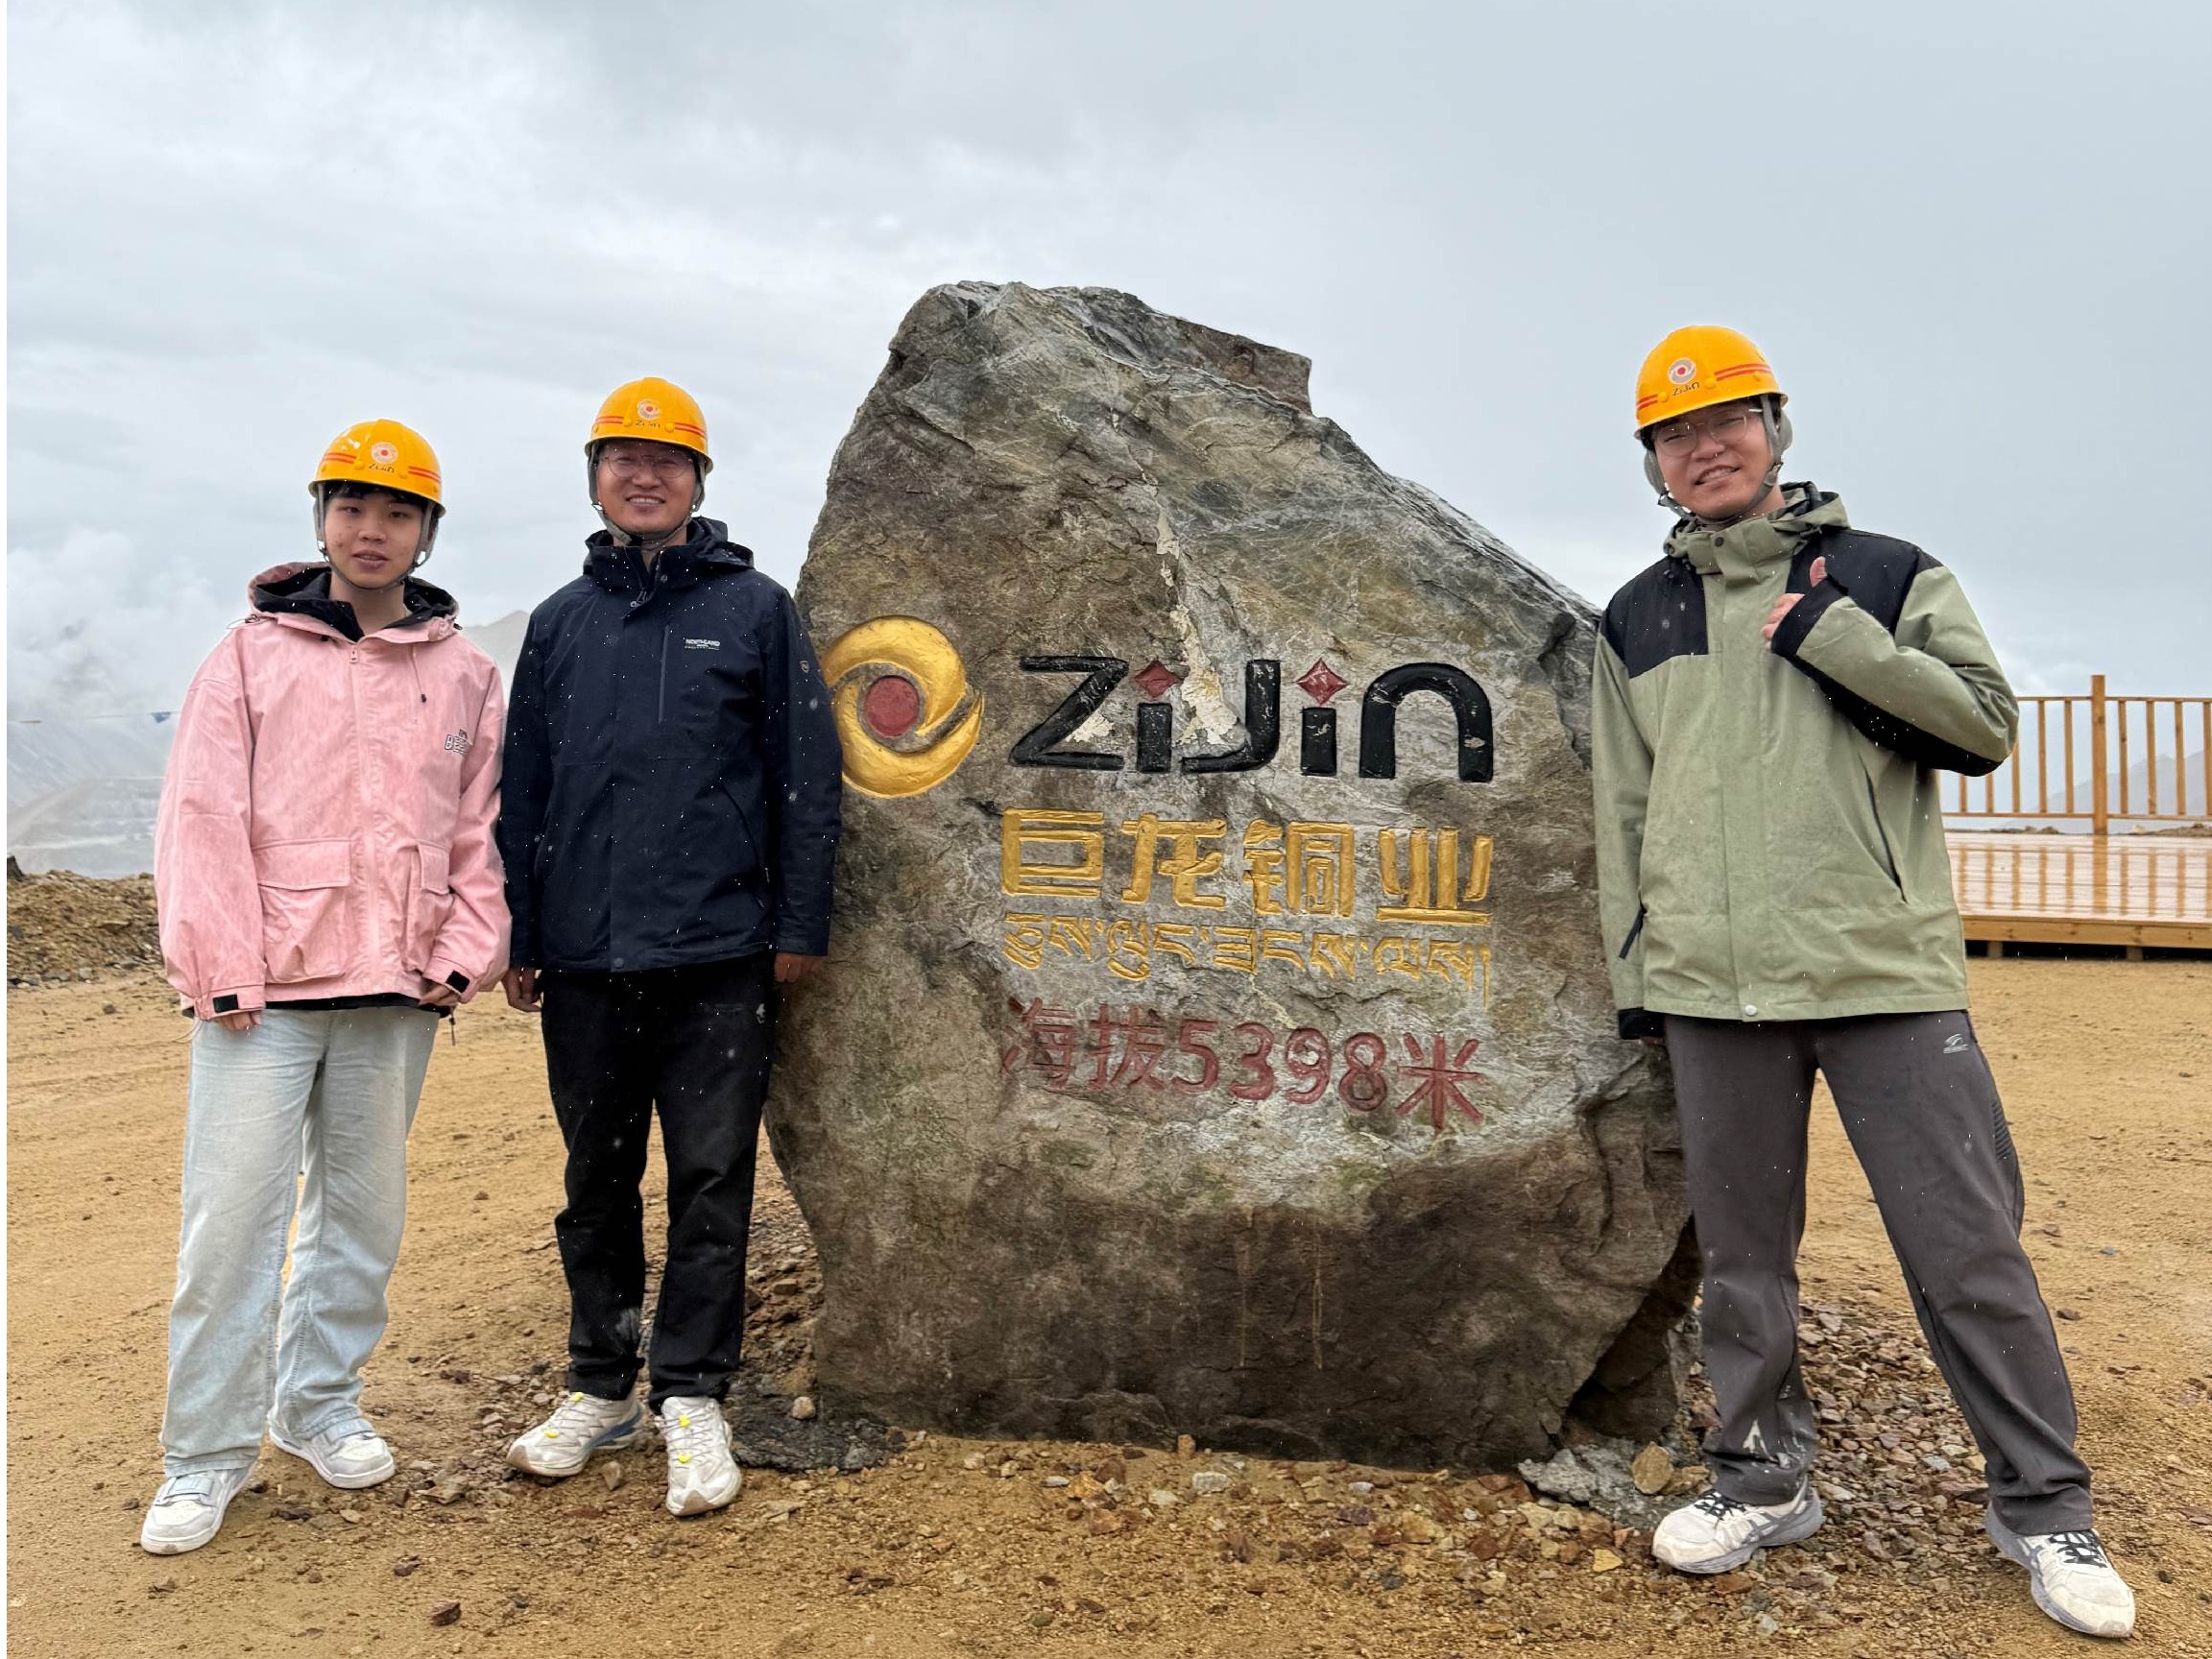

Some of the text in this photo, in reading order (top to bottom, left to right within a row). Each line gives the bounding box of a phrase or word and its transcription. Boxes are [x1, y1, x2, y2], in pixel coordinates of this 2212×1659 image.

[1001, 806, 1494, 925] 巨龙铜业
[999, 996, 1485, 1129] 海拔5398米
